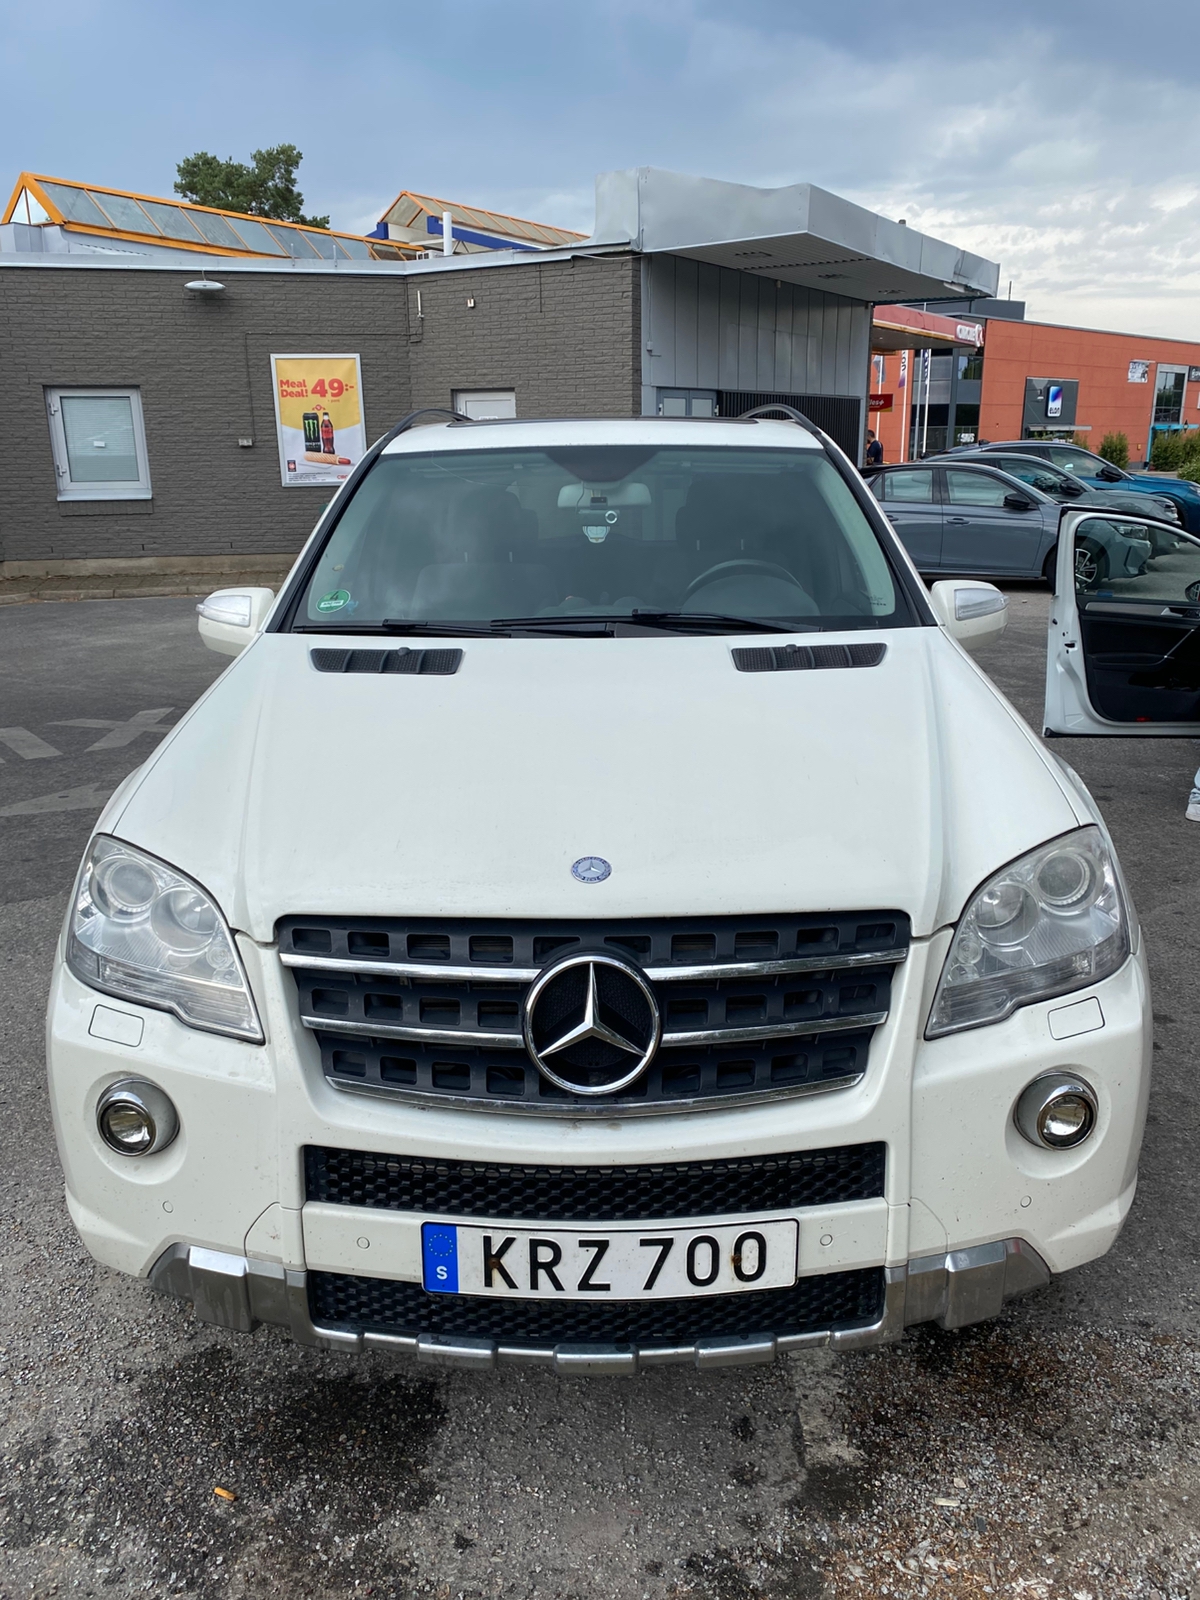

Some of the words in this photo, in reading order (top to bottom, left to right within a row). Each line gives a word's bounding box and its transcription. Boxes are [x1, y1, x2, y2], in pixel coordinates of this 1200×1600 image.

[280, 379, 307, 388] Meal
[311, 378, 354, 398] 49:-
[281, 389, 308, 398] Deal!
[330, 590, 339, 600] 4
[482, 1235, 611, 1291] KRZ
[639, 1230, 767, 1291] 700
[436, 1266, 448, 1280] S
